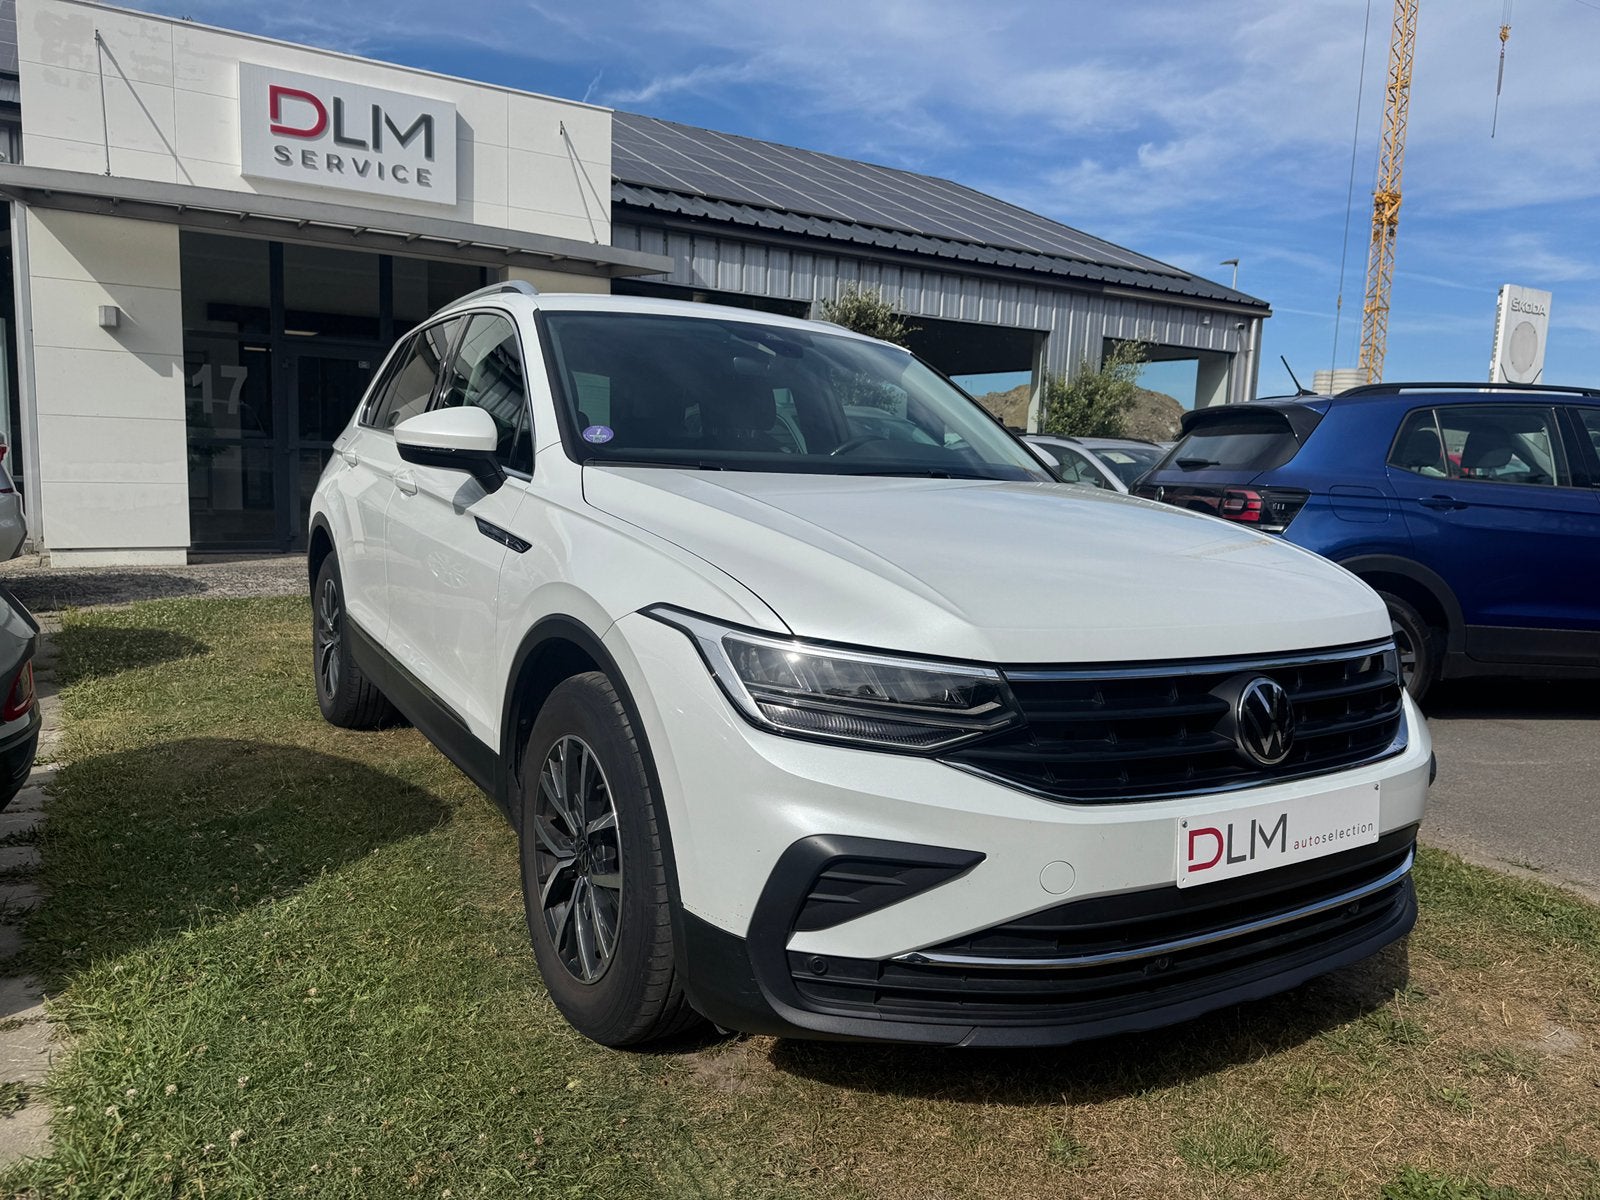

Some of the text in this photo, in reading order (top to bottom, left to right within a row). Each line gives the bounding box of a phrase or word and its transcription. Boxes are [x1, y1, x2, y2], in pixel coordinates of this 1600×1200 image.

[269, 84, 433, 160] DLM
[273, 144, 433, 188] SERVICE
[192, 364, 248, 414] 17
[1188, 813, 1374, 873] DLM autoselection
